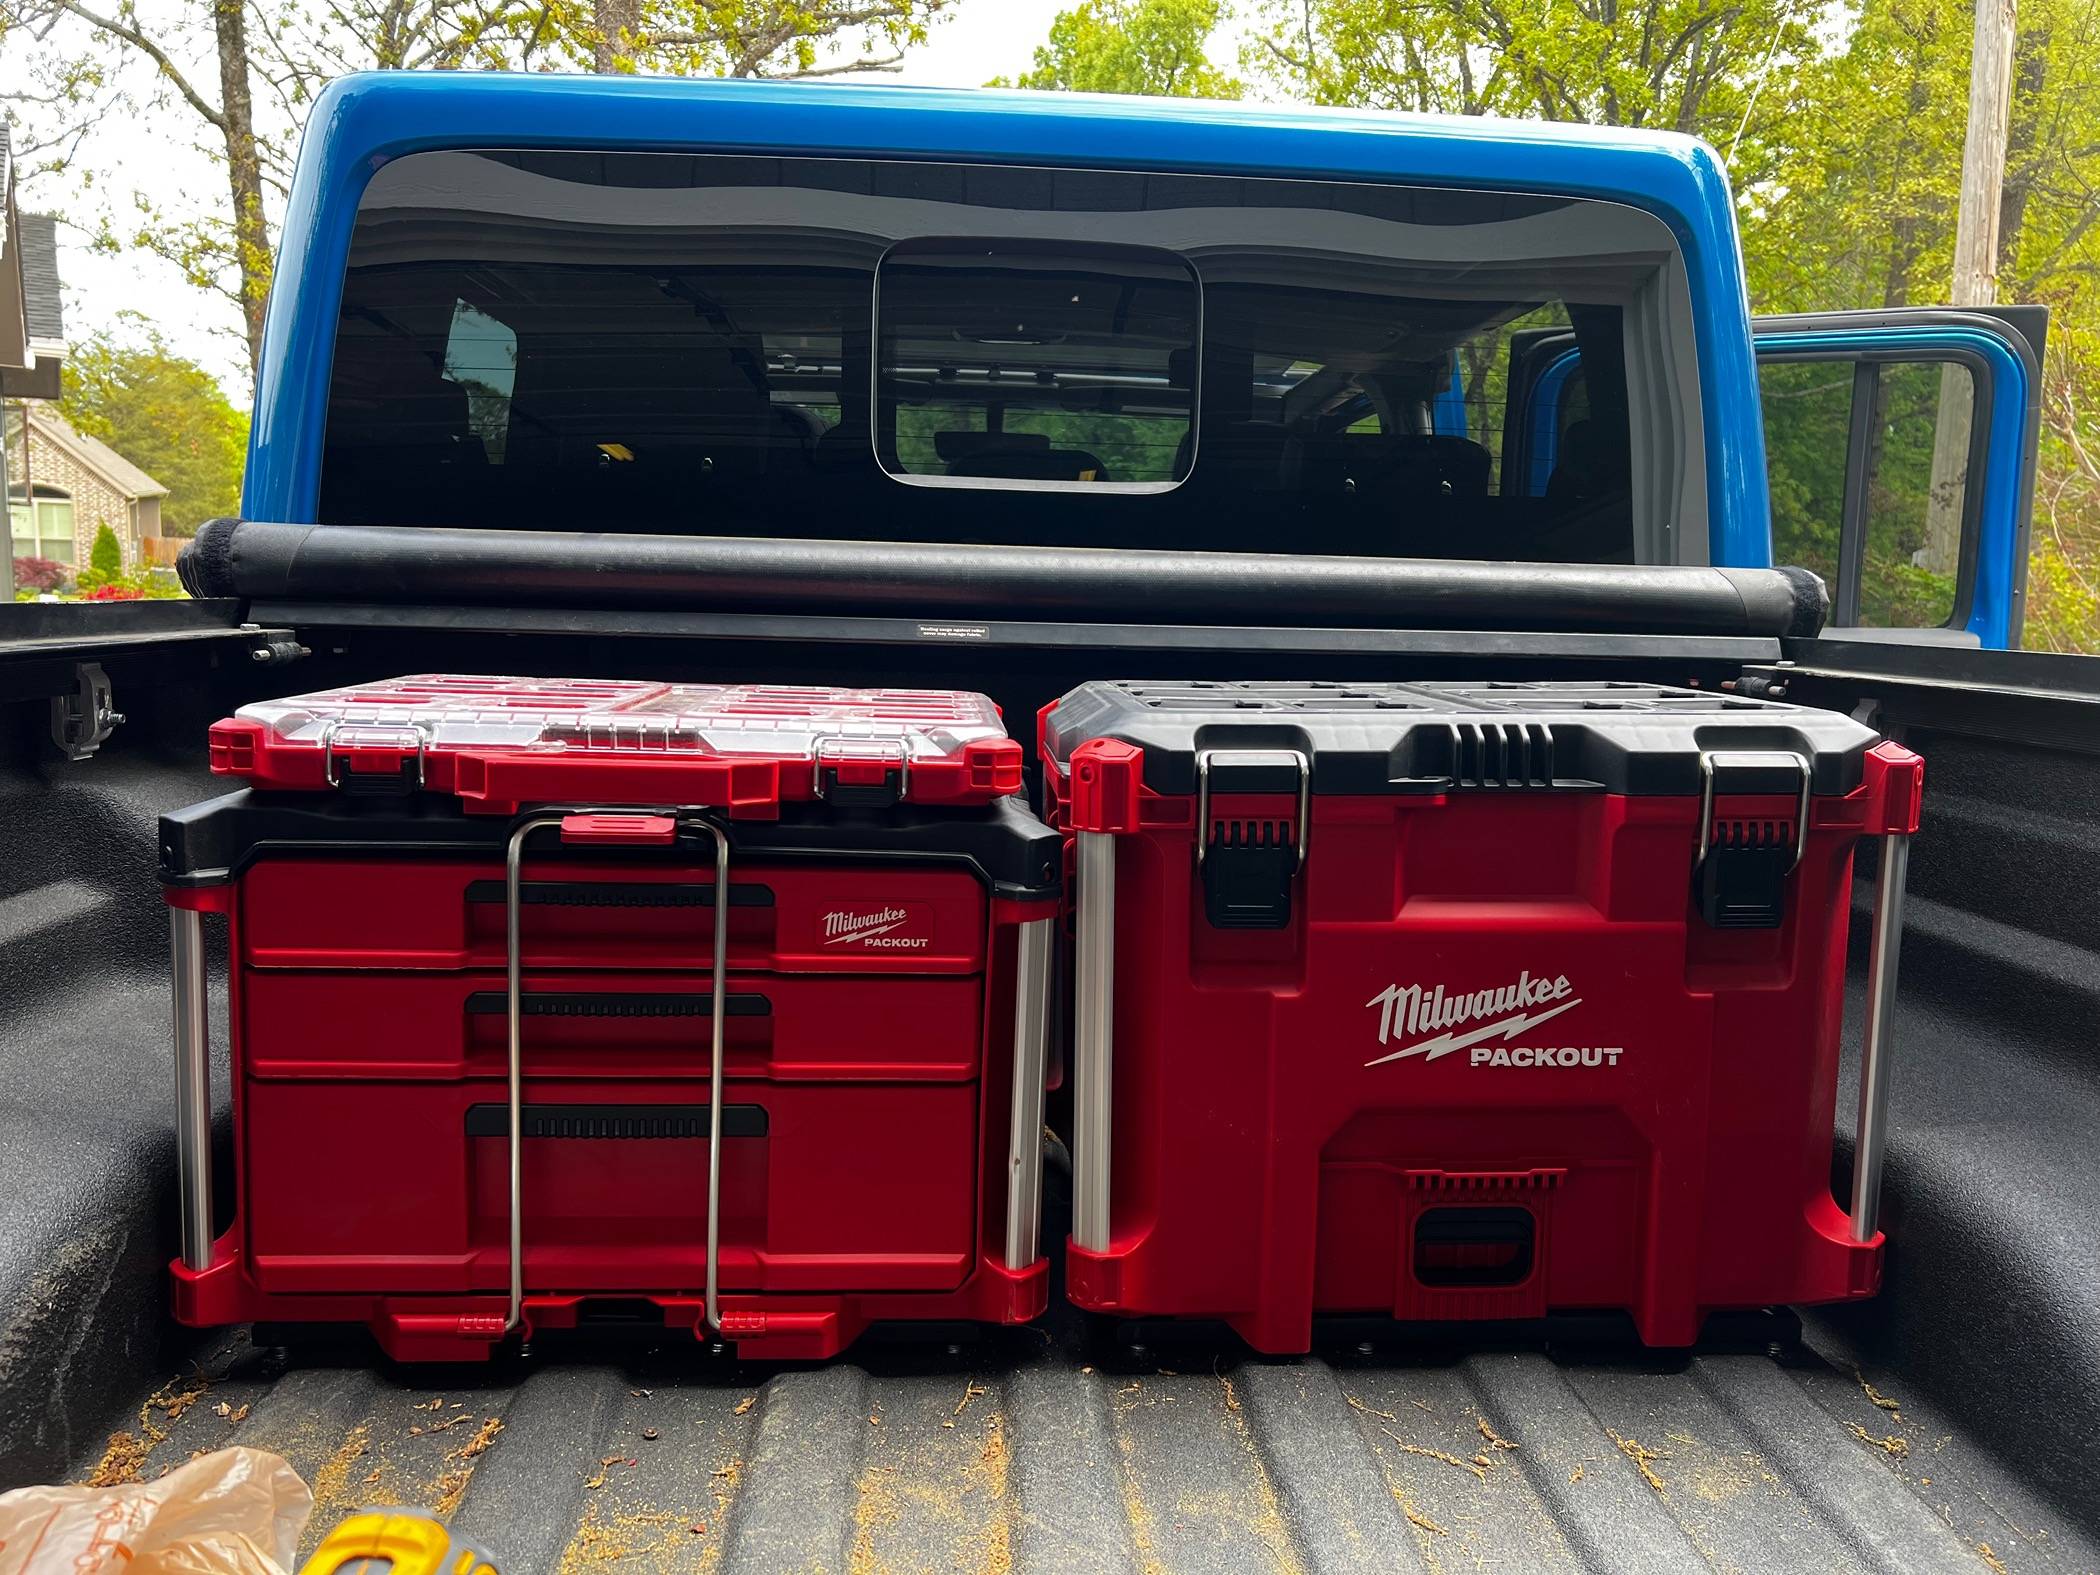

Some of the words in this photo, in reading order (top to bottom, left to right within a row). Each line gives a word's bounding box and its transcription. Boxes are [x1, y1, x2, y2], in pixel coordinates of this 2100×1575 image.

[822, 907, 907, 937] Milwaukee
[864, 938, 928, 948] PACKOUT
[1366, 970, 1573, 1045] Milwaukee
[1470, 1047, 1623, 1067] PACKOUT
